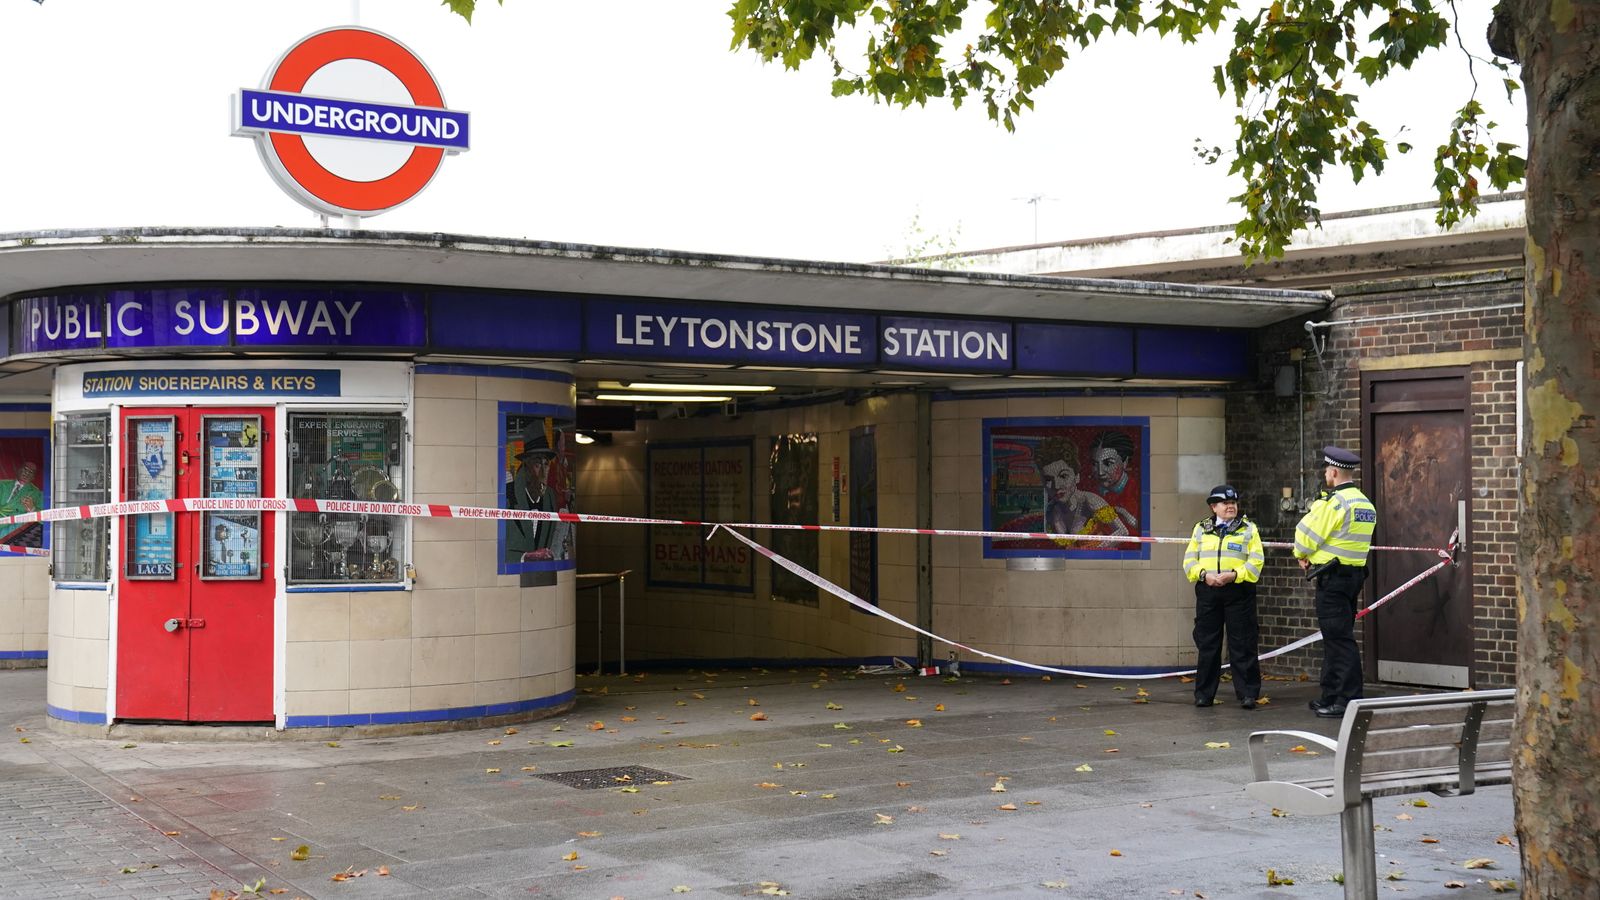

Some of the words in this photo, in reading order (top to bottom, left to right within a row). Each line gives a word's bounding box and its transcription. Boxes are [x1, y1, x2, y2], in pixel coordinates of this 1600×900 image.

[251, 98, 460, 140] UNDERGROUND
[31, 302, 143, 342] PUBLIC
[174, 300, 362, 336] SUBWAY
[616, 313, 862, 354] LEYTONSTONE
[884, 326, 1008, 361] STATION
[83, 376, 134, 393] STATION
[253, 376, 265, 390] &
[271, 376, 315, 390] KEYS
[300, 421, 332, 429] EXPERT
[335, 421, 384, 429] ENGRAVING
[326, 429, 364, 437] SERVICE
[94, 504, 106, 515] POLICE
[107, 504, 119, 514] LINE
[120, 503, 128, 513] DO
[128, 502, 140, 513] NOT
[141, 501, 160, 512] CROSS
[193, 500, 216, 509] POLICE
[218, 500, 233, 509] LINE
[235, 500, 245, 509] DO
[247, 500, 261, 509] NOT
[262, 499, 287, 510] CROSS
[325, 501, 350, 512] POLICE
[352, 502, 368, 512] LINE
[370, 503, 380, 513] DO
[381, 503, 396, 513] NOT
[397, 504, 422, 514] CROSS
[459, 507, 483, 518] POLICE
[485, 508, 500, 518] LINE
[501, 509, 511, 519] DO
[512, 510, 526, 519] NOT
[527, 511, 551, 520] CROSS
[1354, 511, 1376, 522] POLICE
[655, 543, 746, 564] BEARMANS
